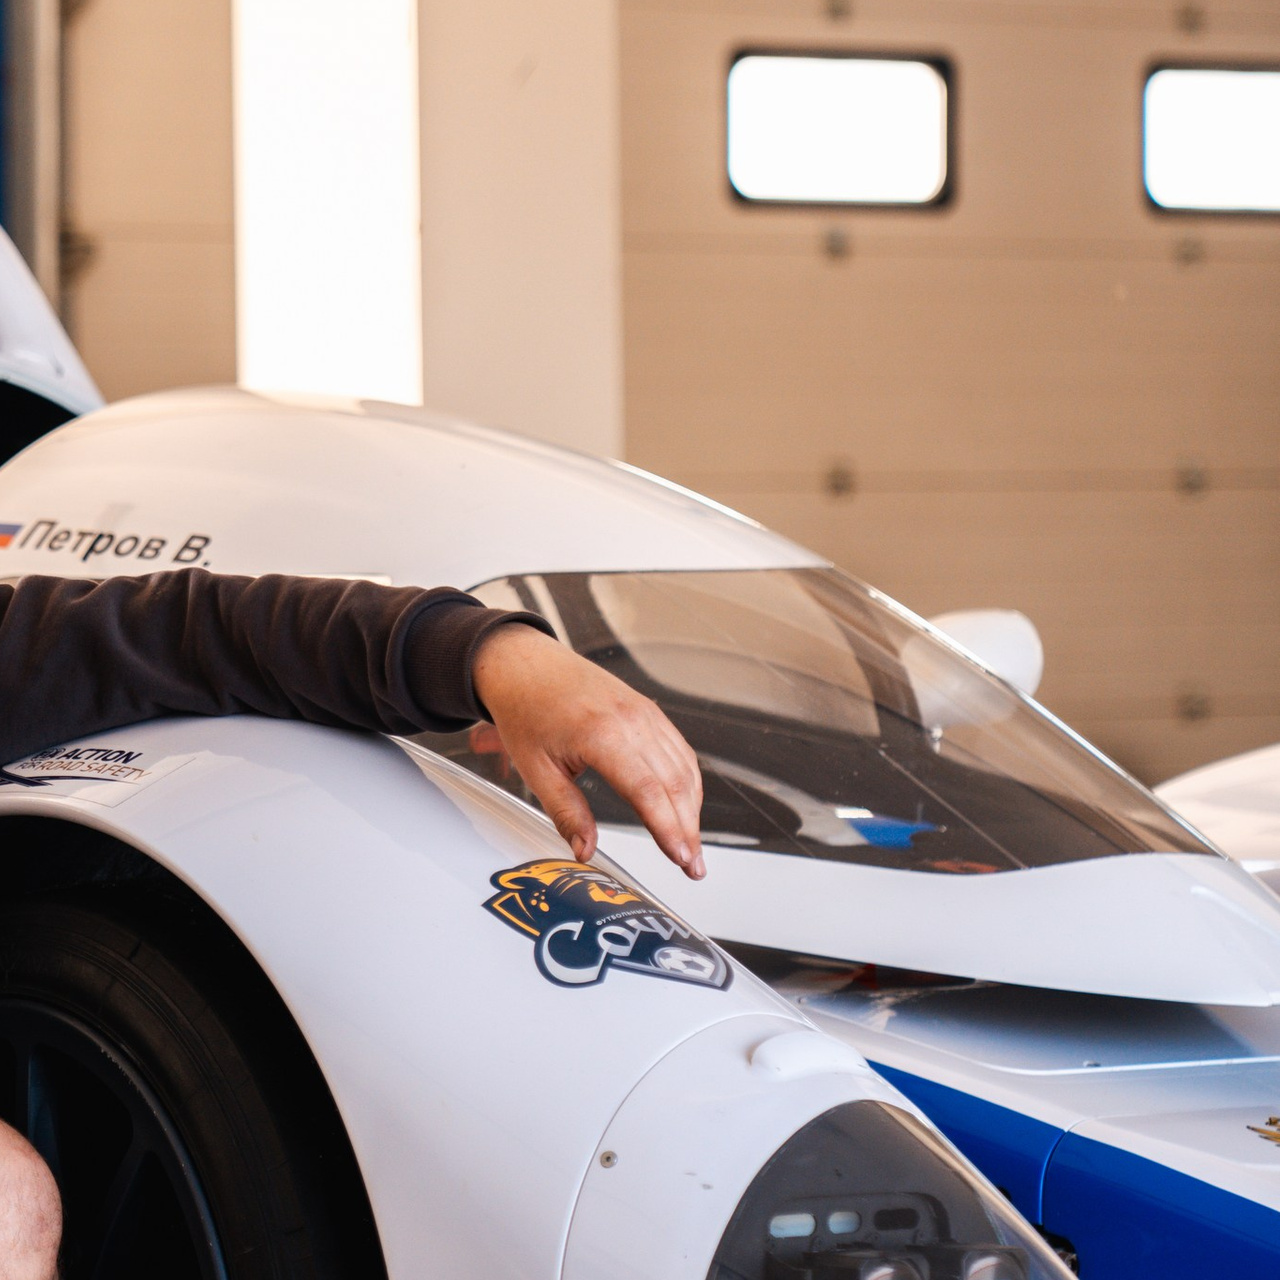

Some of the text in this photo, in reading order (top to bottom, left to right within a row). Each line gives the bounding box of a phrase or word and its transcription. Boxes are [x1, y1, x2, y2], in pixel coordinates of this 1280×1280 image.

[19, 519, 212, 567] Петров В.
[58, 748, 143, 764] ACTION
[34, 761, 85, 771] ROAD
[80, 762, 152, 780] SAFETY
[595, 908, 647, 926] ФУТБОЛЬНЫЙ
